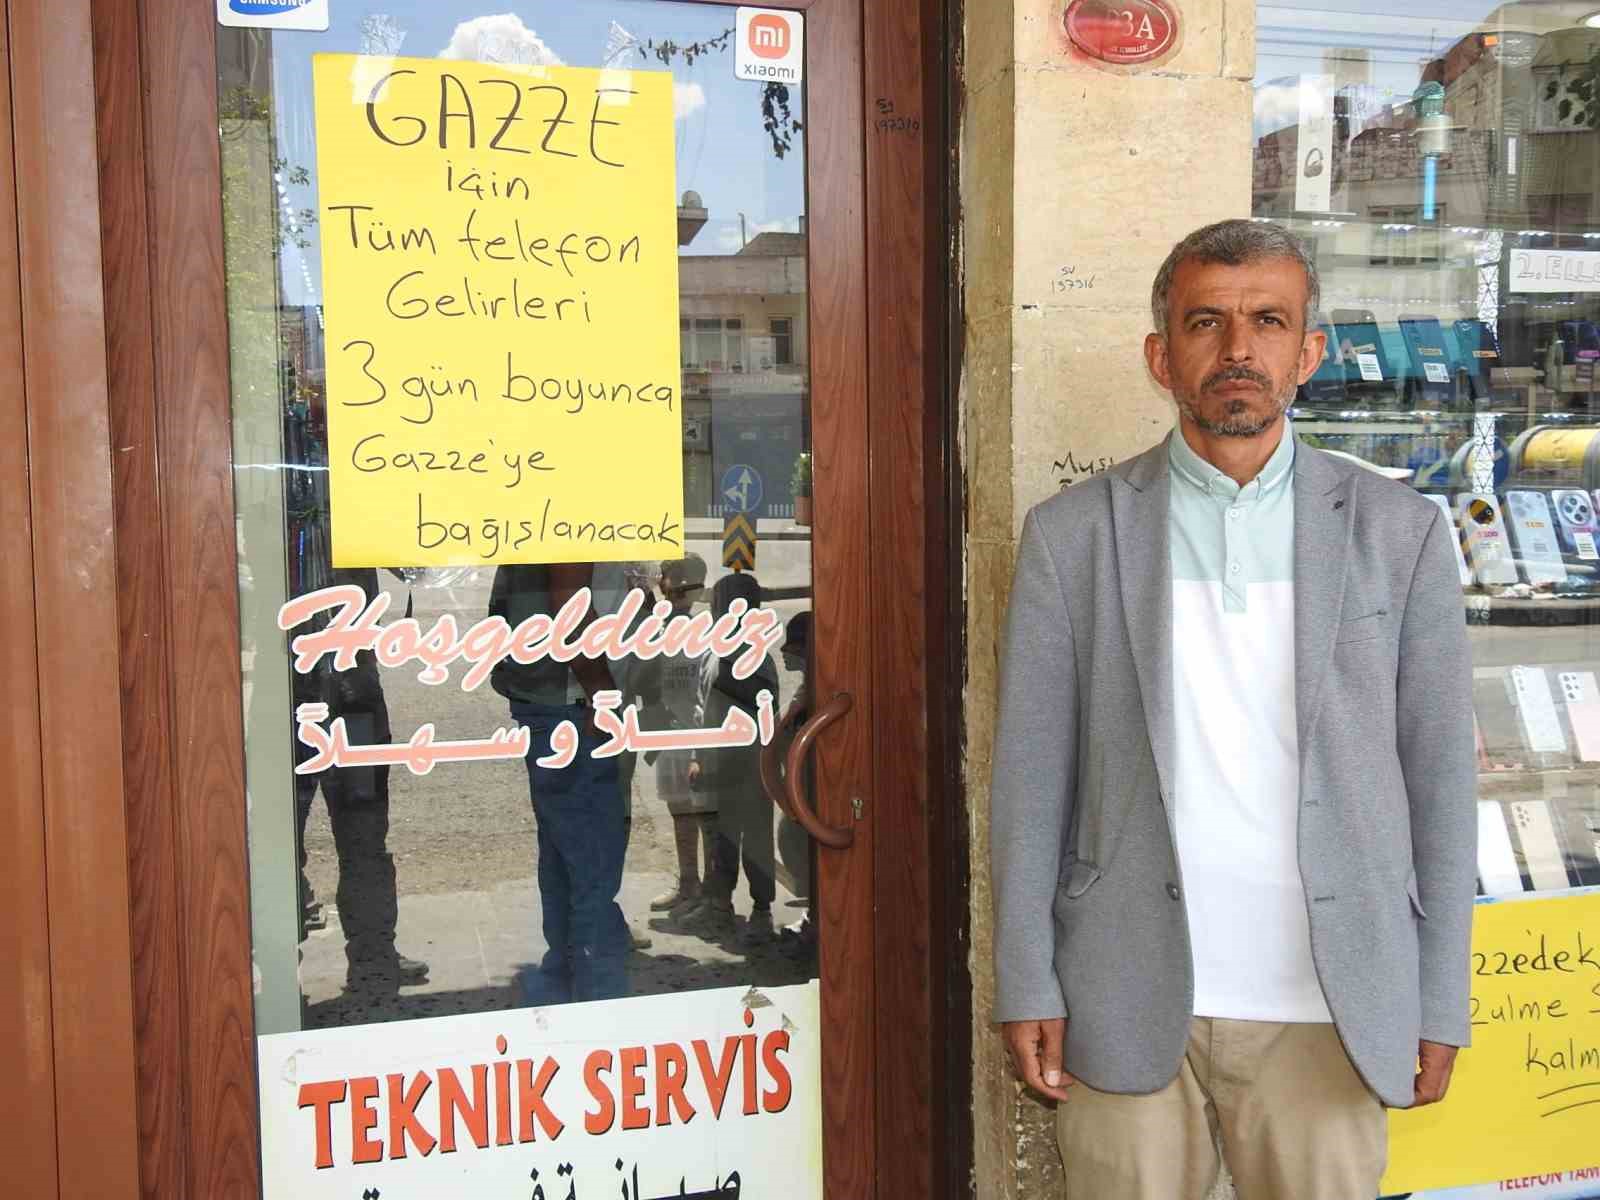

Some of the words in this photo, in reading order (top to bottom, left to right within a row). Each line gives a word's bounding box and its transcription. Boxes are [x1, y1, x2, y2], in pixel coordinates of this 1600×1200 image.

[744, 64, 795, 79] xiaomi
[366, 69, 638, 167] GAZZE
[328, 205, 436, 254] Tüm
[458, 208, 640, 277] telefon
[386, 269, 591, 322] Gelirleri
[342, 340, 387, 407] 3
[401, 365, 478, 425] gün
[502, 352, 673, 414] boyunca
[351, 433, 555, 489] Gazze'ye
[417, 493, 680, 559] bağışlanacak
[278, 585, 783, 691] Hoşgeldiniz
[536, 720, 579, 768] و
[297, 1034, 564, 1169] TEKNİK
[583, 1008, 792, 1135] SERVİS
